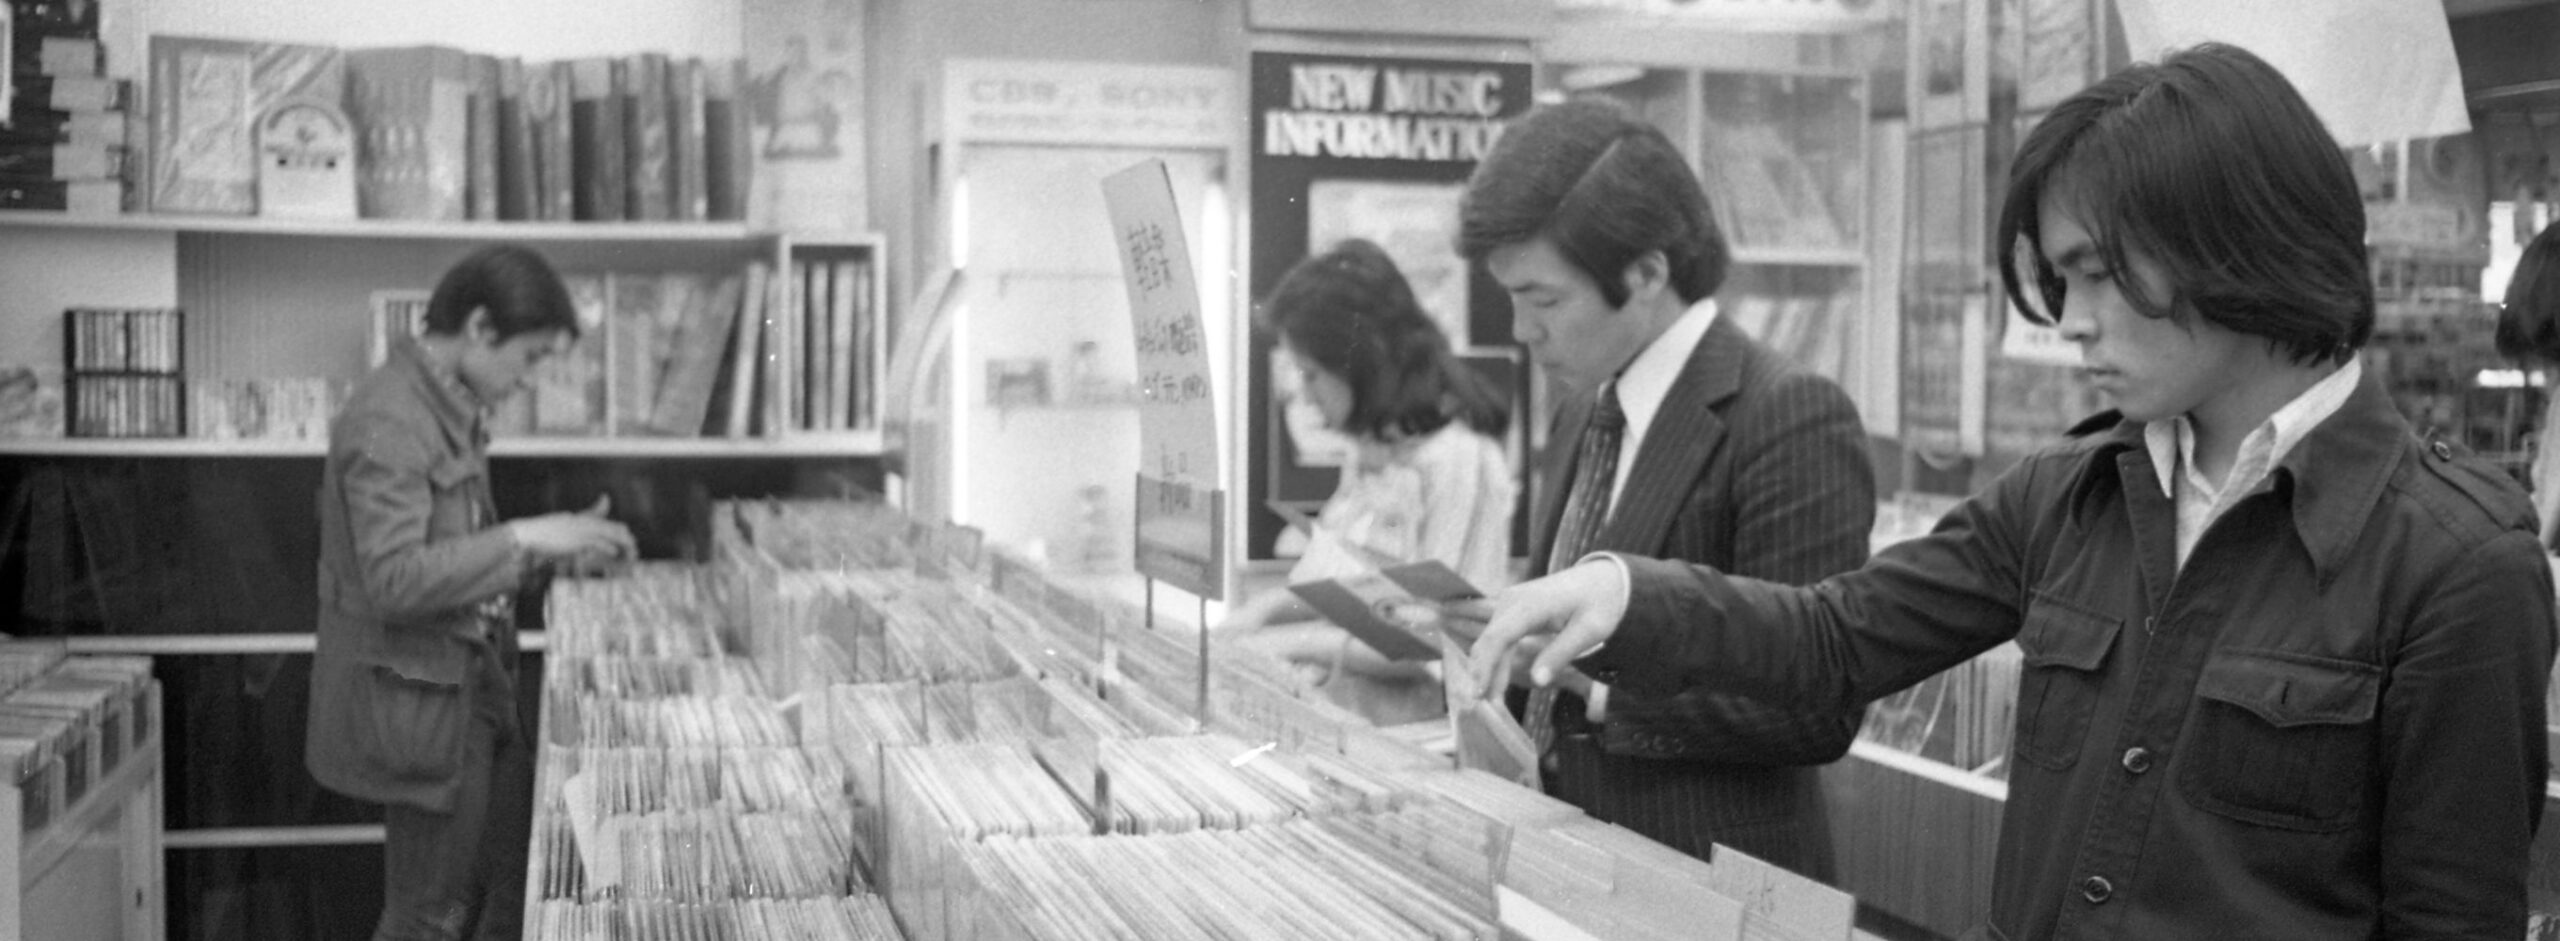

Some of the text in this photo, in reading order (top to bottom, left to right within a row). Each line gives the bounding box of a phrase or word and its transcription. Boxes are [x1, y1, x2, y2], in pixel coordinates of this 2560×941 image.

[1291, 64, 1503, 117] NEW MUSIC
[1265, 109, 1506, 162] INFORMATIO
